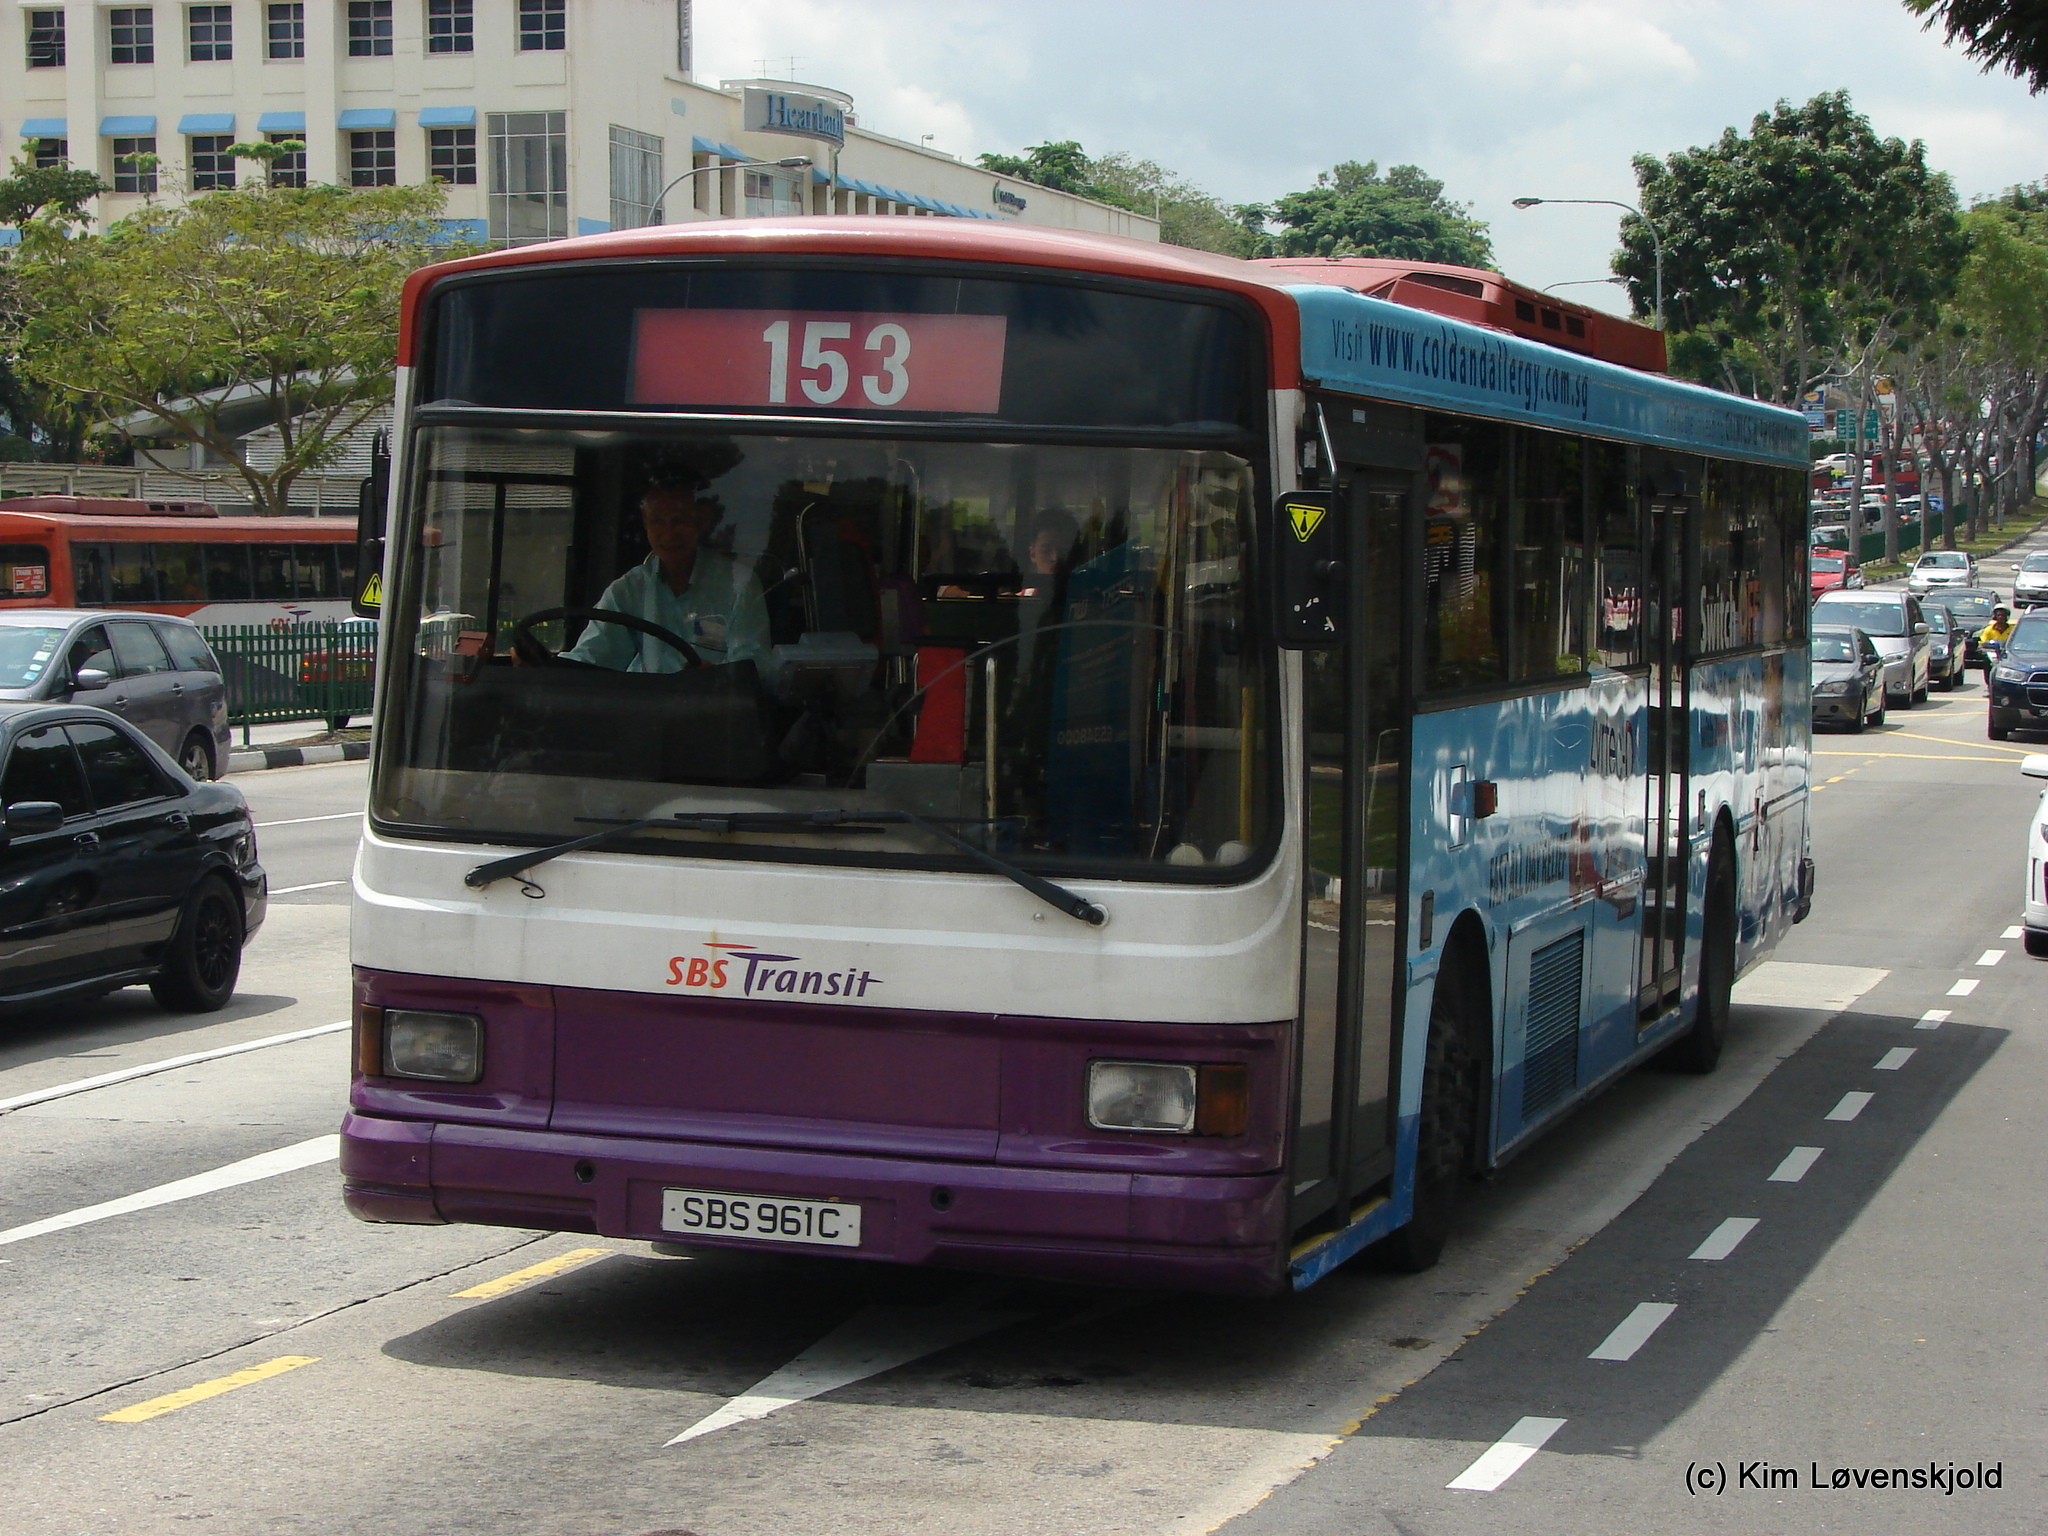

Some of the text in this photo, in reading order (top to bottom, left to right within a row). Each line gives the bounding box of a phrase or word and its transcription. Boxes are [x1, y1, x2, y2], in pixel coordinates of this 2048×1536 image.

[762, 319, 912, 407] 153
[1332, 318, 1364, 364] Visit
[1368, 322, 1589, 421] www.coldandallergy.com.sg
[666, 951, 884, 998] SBS Transit
